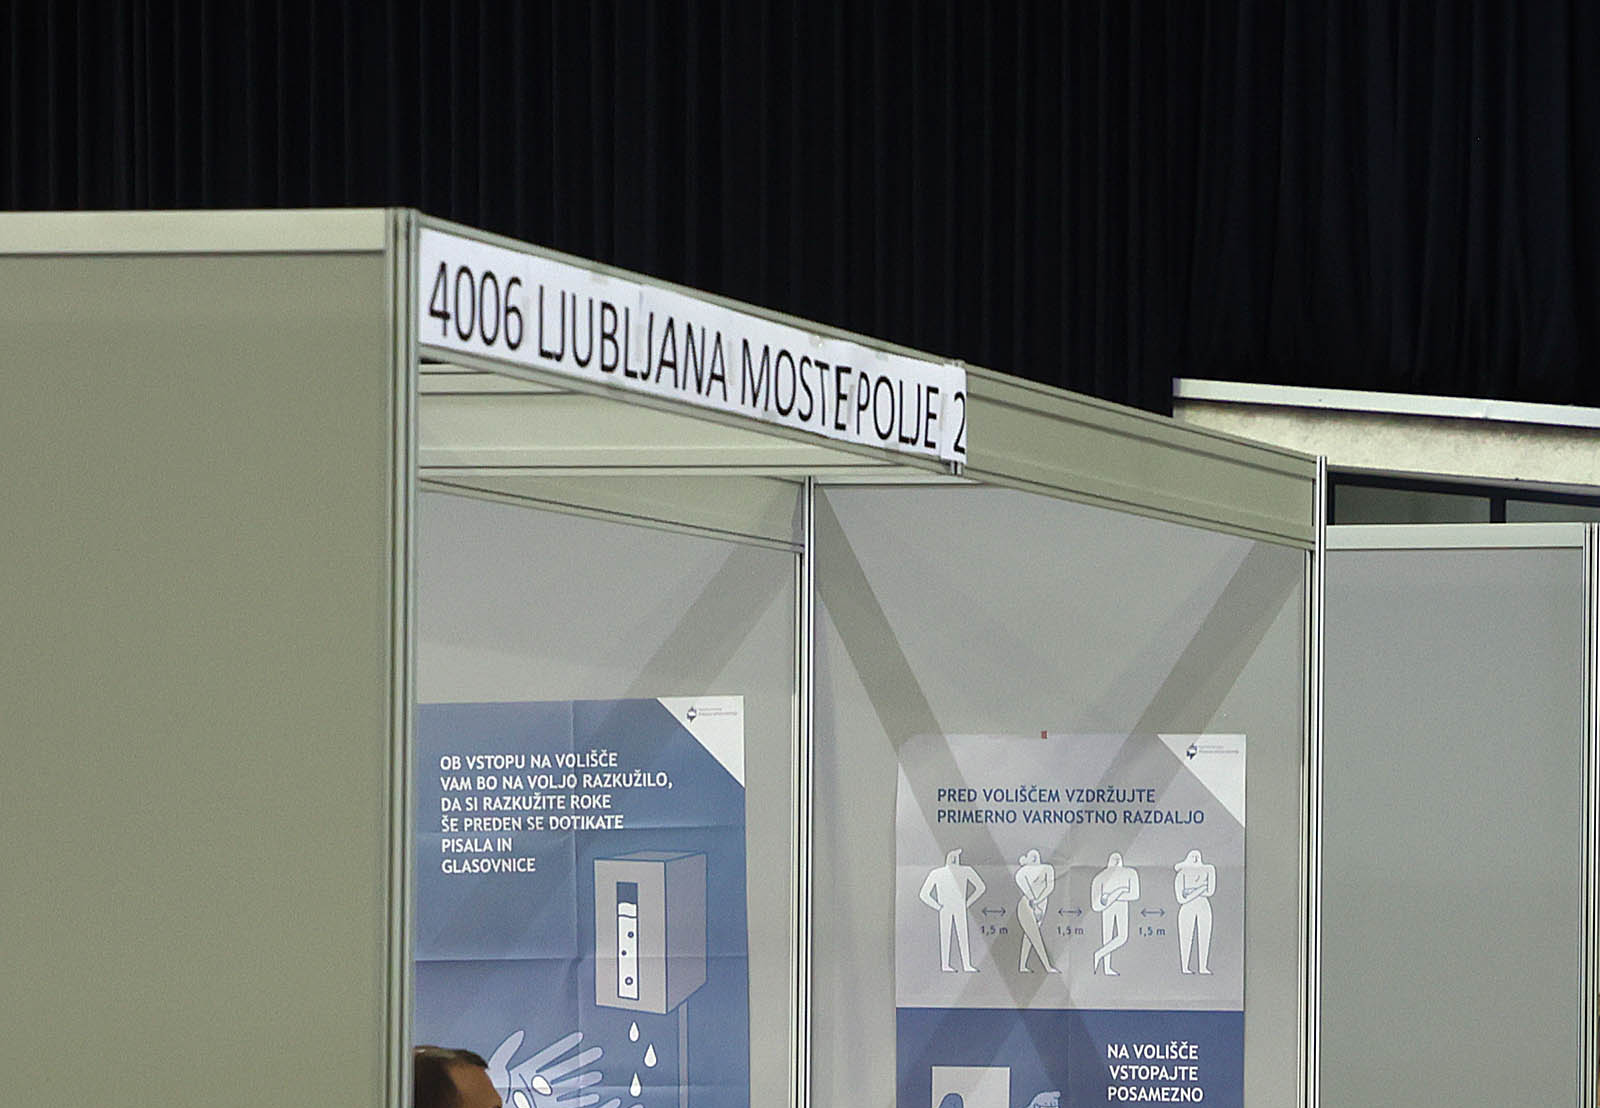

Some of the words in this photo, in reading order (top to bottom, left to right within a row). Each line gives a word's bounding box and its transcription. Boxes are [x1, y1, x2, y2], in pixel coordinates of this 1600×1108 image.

[429, 261, 524, 351] 4006
[537, 283, 729, 403] LJUBLJANA
[953, 391, 967, 455] 2
[440, 756, 461, 771] OB
[466, 754, 526, 770] VSTOPU
[530, 754, 552, 769] NA
[555, 749, 618, 769] VOLIŠČE
[440, 776, 472, 791] VAM
[476, 775, 498, 790] BO
[502, 775, 523, 790] NA
[527, 774, 578, 789] VOLJO
[582, 768, 673, 790] RAZKUŽILO,
[441, 798, 462, 813] DA
[465, 797, 478, 812] SI
[483, 792, 566, 811] RAZKUŽITE
[570, 795, 612, 810] ROKE
[937, 789, 978, 803] PRED
[982, 785, 1061, 804] VOLIŠČEM
[1065, 785, 1156, 803] VZDRŽUJTE
[441, 814, 459, 833] ŠE
[464, 816, 522, 832] PREDEN
[527, 816, 544, 831] SE
[549, 815, 624, 830] DOTIKATE
[937, 810, 1017, 825] PRIMERNO
[1023, 810, 1118, 825] VARNOSTNO
[1123, 810, 1205, 825] RAZDALJO
[441, 838, 494, 854] PISALA
[497, 838, 512, 853] IN
[441, 858, 537, 875] GLASOVNICE
[1107, 1044, 1129, 1059] NA
[1133, 1041, 1199, 1060] VOLIŠČE
[1109, 1065, 1199, 1081] VSTOPAJTE
[1107, 1087, 1204, 1103] POSAMEZNO
